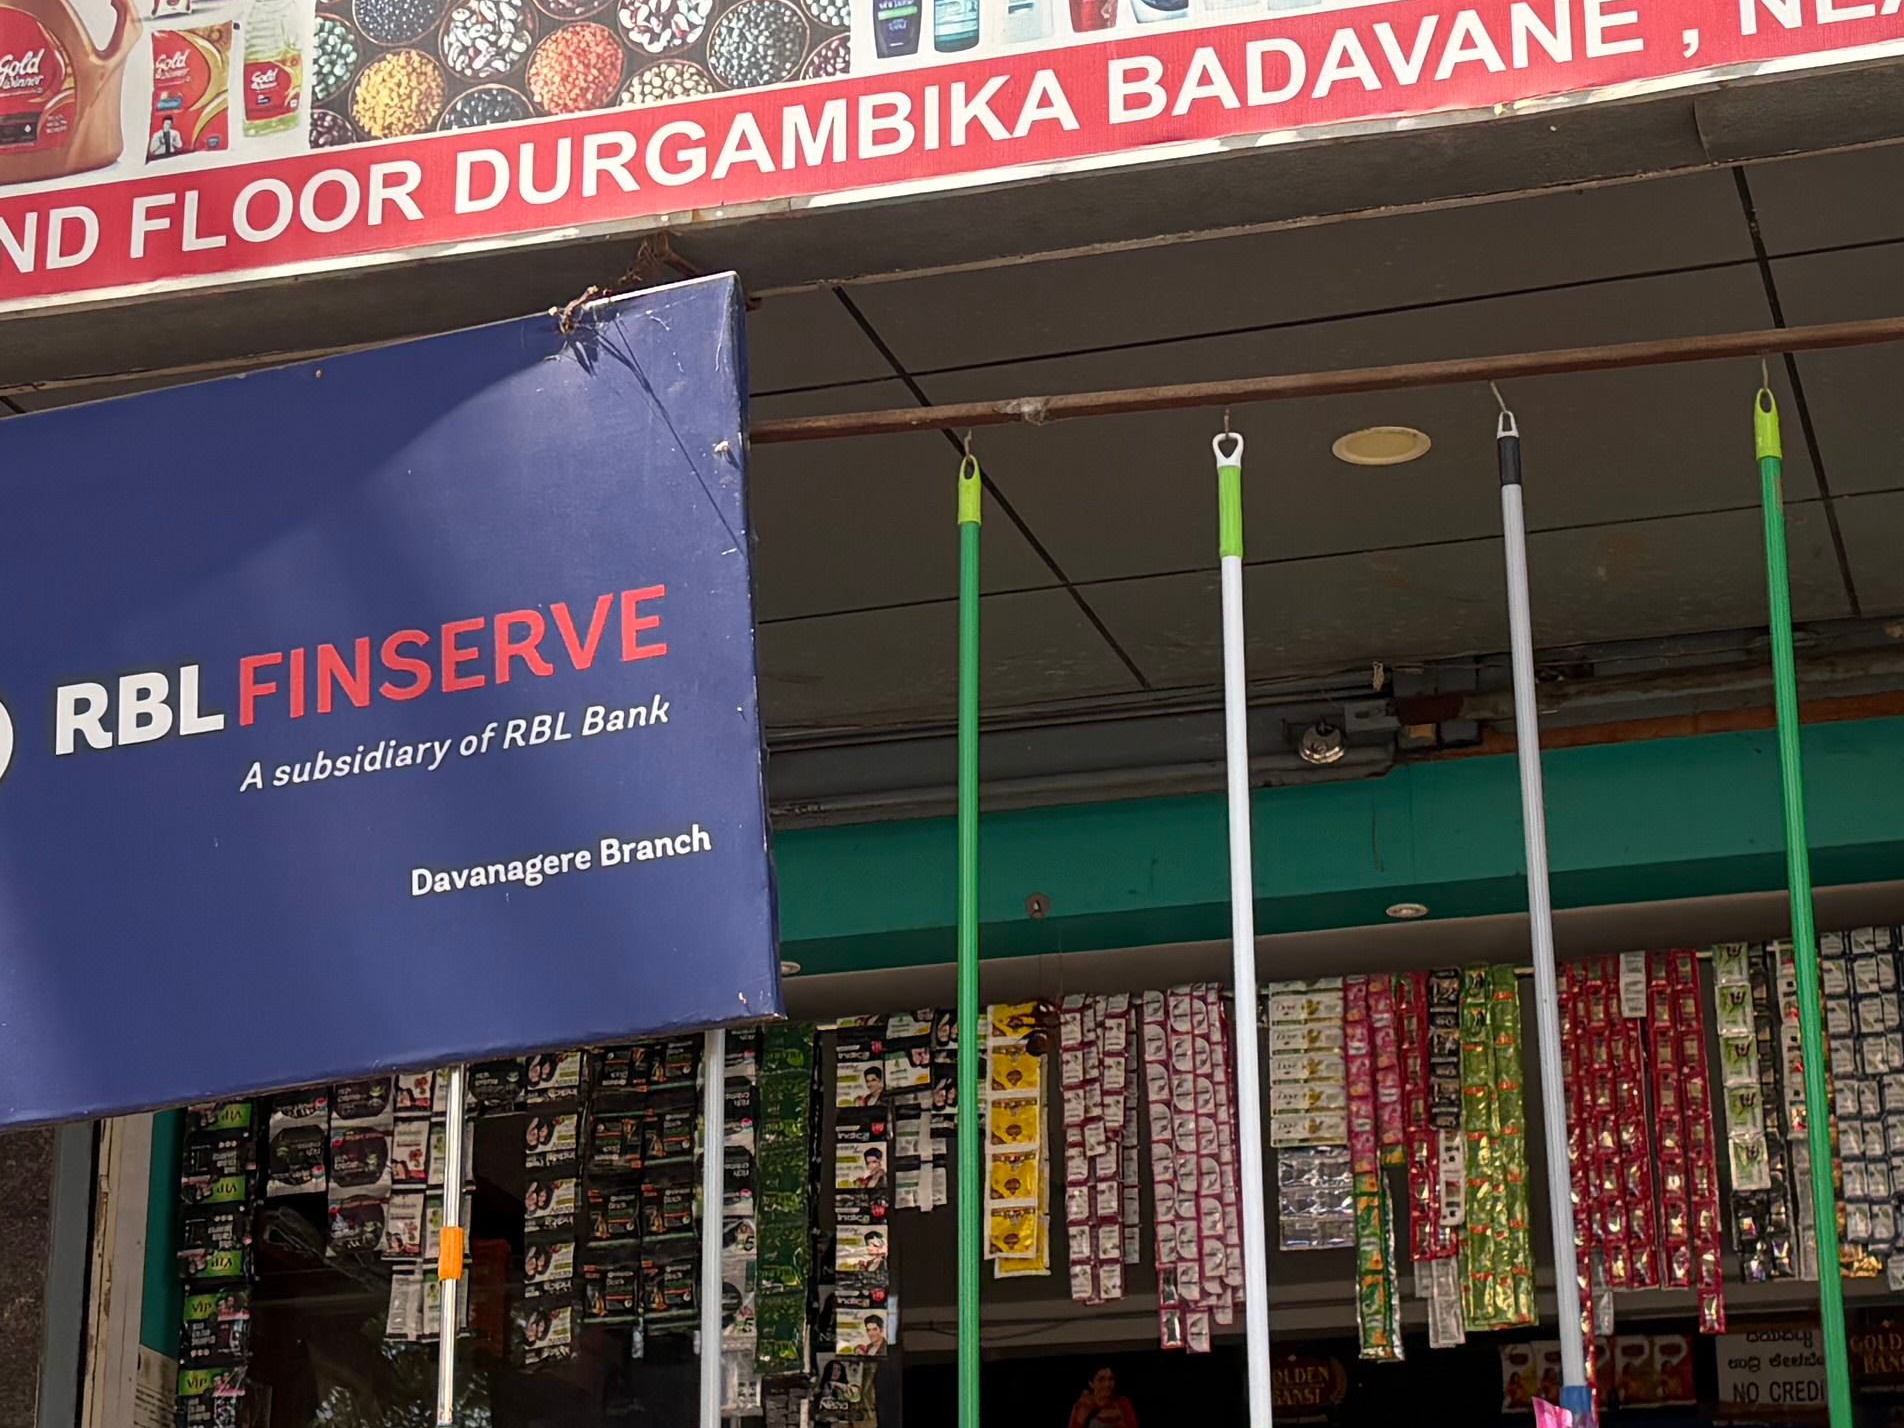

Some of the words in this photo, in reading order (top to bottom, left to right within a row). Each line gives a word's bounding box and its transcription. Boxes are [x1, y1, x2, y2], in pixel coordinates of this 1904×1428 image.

[155, 49, 191, 78] Gold
[130, 157, 425, 260] FLOOR
[453, 79, 1081, 216] DURGAMBIKA
[53, 663, 226, 758] RBL
[238, 584, 669, 728] FINSERVE
[239, 761, 264, 793] A
[271, 734, 453, 789] subsidiary
[458, 718, 498, 758] of
[502, 709, 572, 750] RBL
[580, 692, 672, 735] Bank
[409, 847, 593, 898] Davanagere
[597, 823, 712, 870] Branch
[1733, 1381, 1759, 1403] NO
[1769, 1379, 1825, 1403] CREDI
